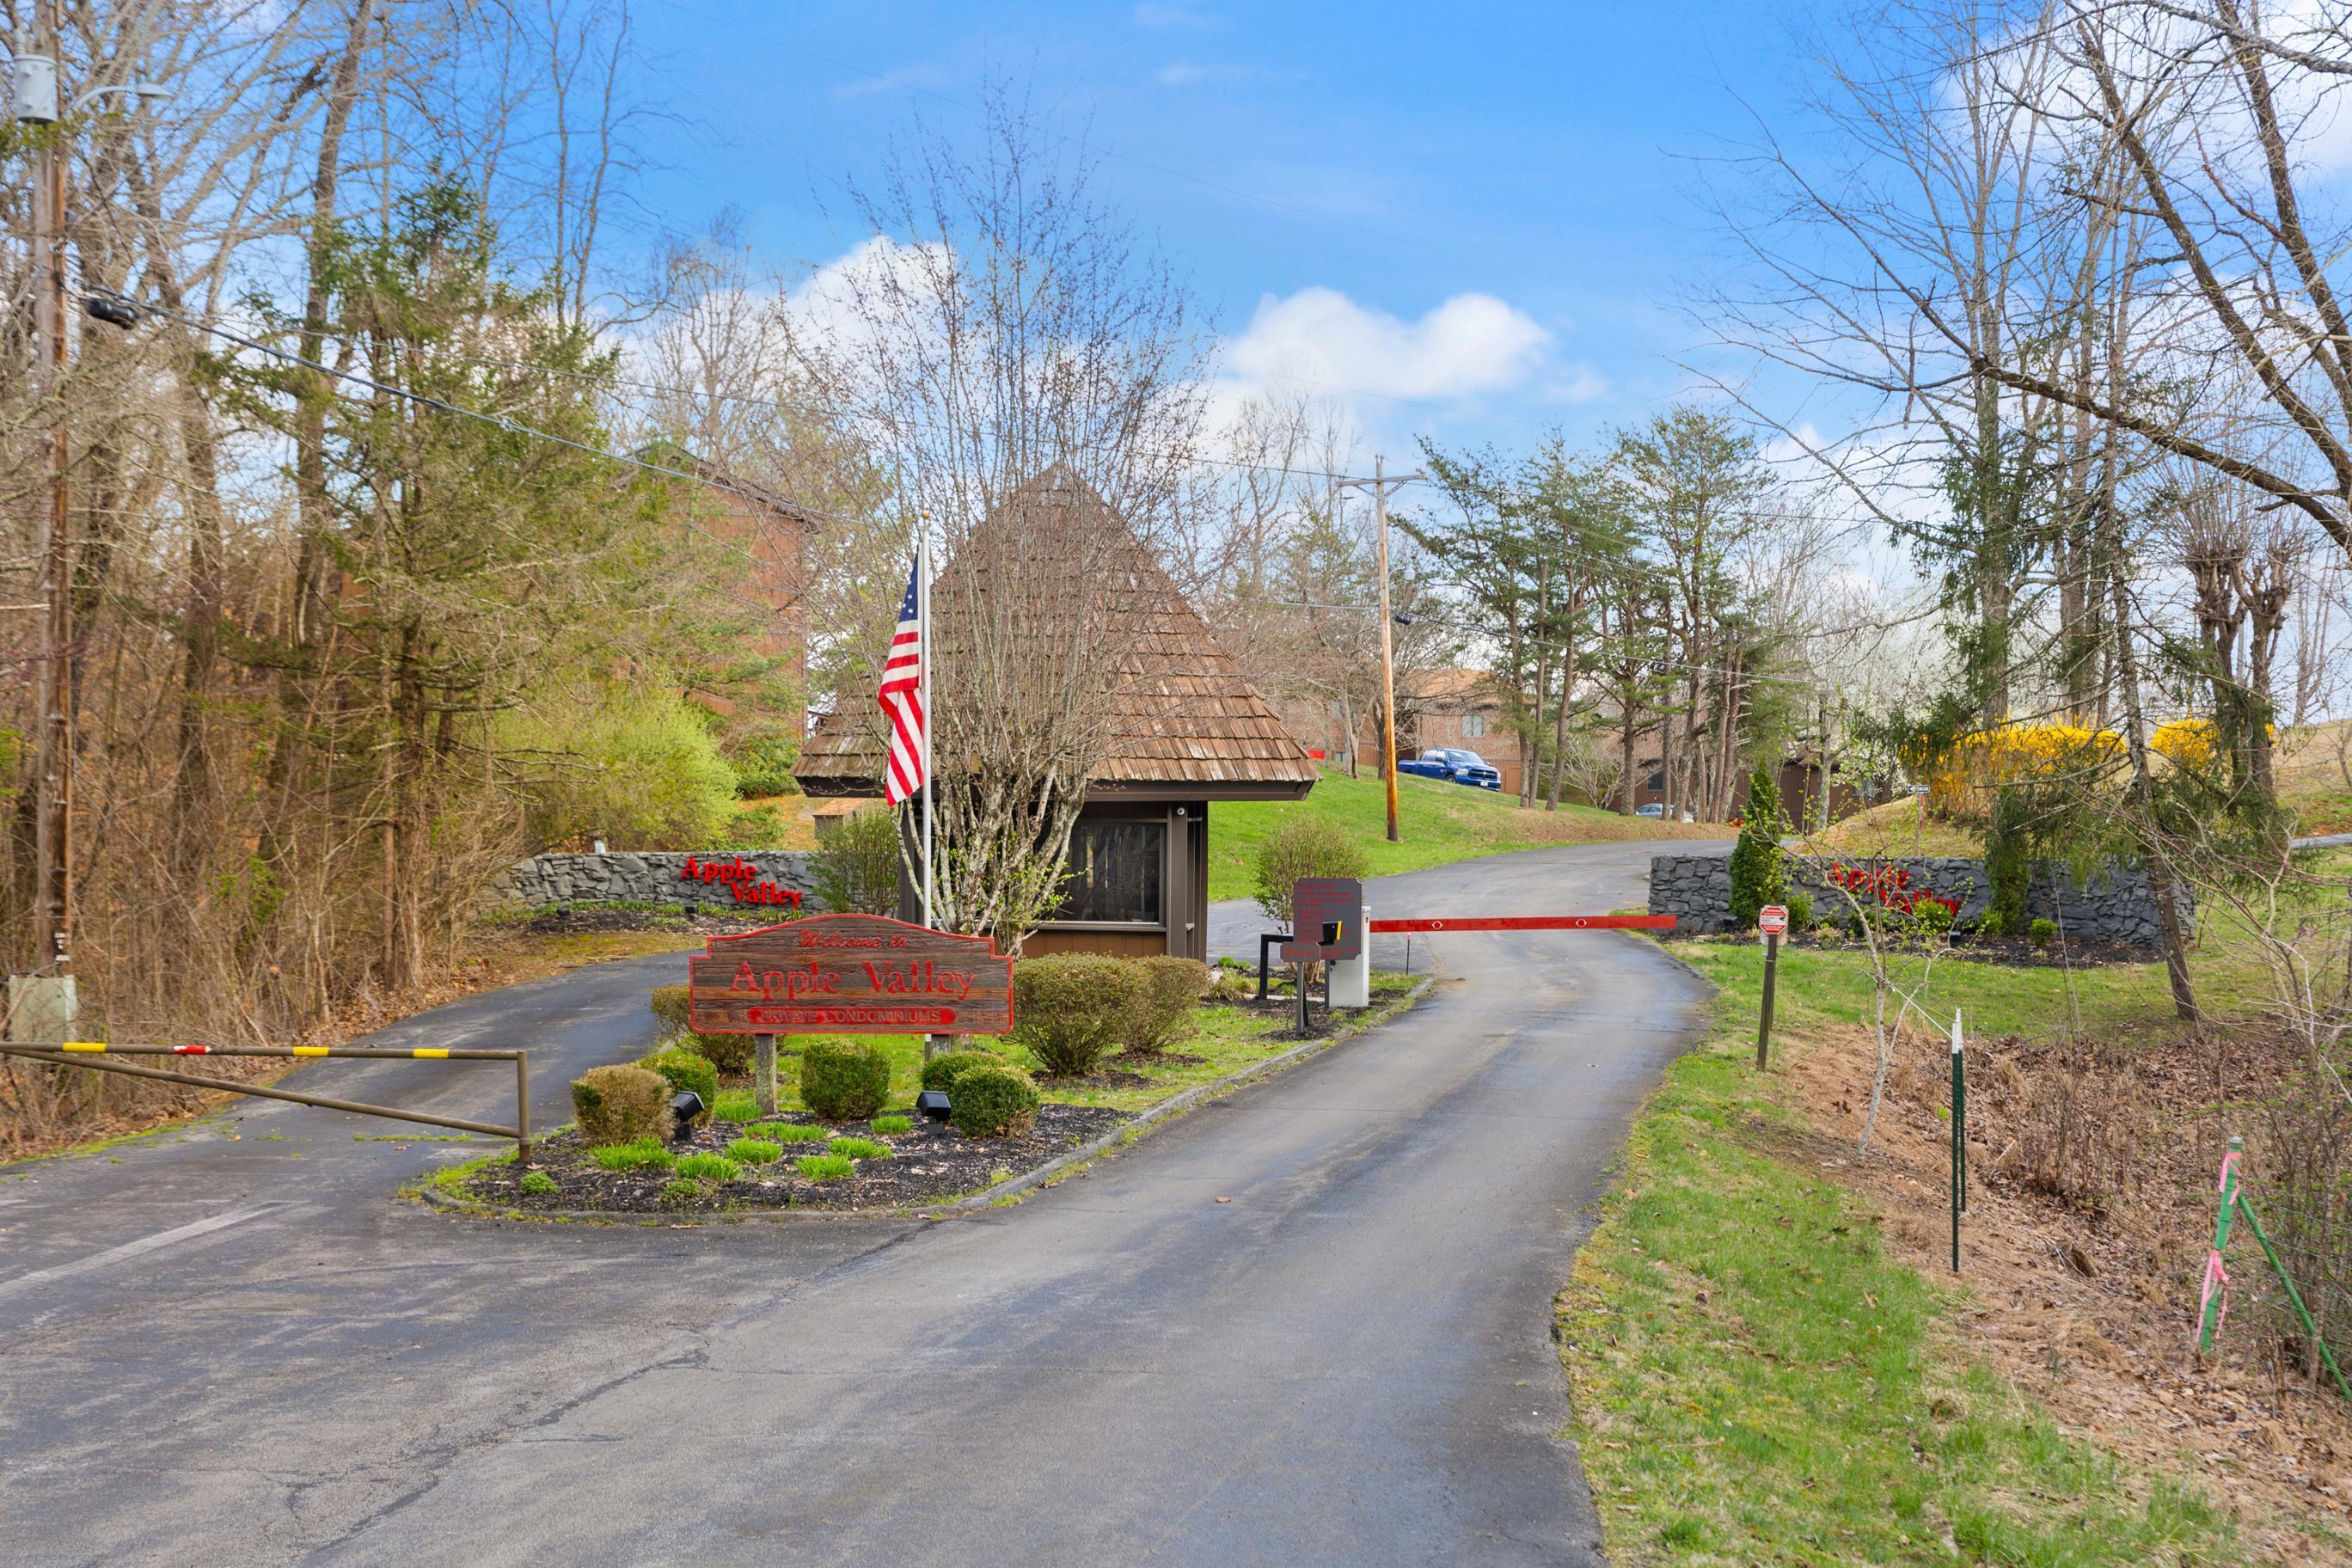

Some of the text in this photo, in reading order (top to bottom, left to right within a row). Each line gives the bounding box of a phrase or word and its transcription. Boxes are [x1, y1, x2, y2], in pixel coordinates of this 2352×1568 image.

[682, 855, 757, 885] Apple
[1828, 860, 1912, 892] Apple
[730, 881, 803, 910] Valley
[798, 929, 909, 949] Welcome to
[729, 959, 976, 1001] Apple Valley
[758, 1009, 941, 1023] PRIVATE CONDOMINIUMS
